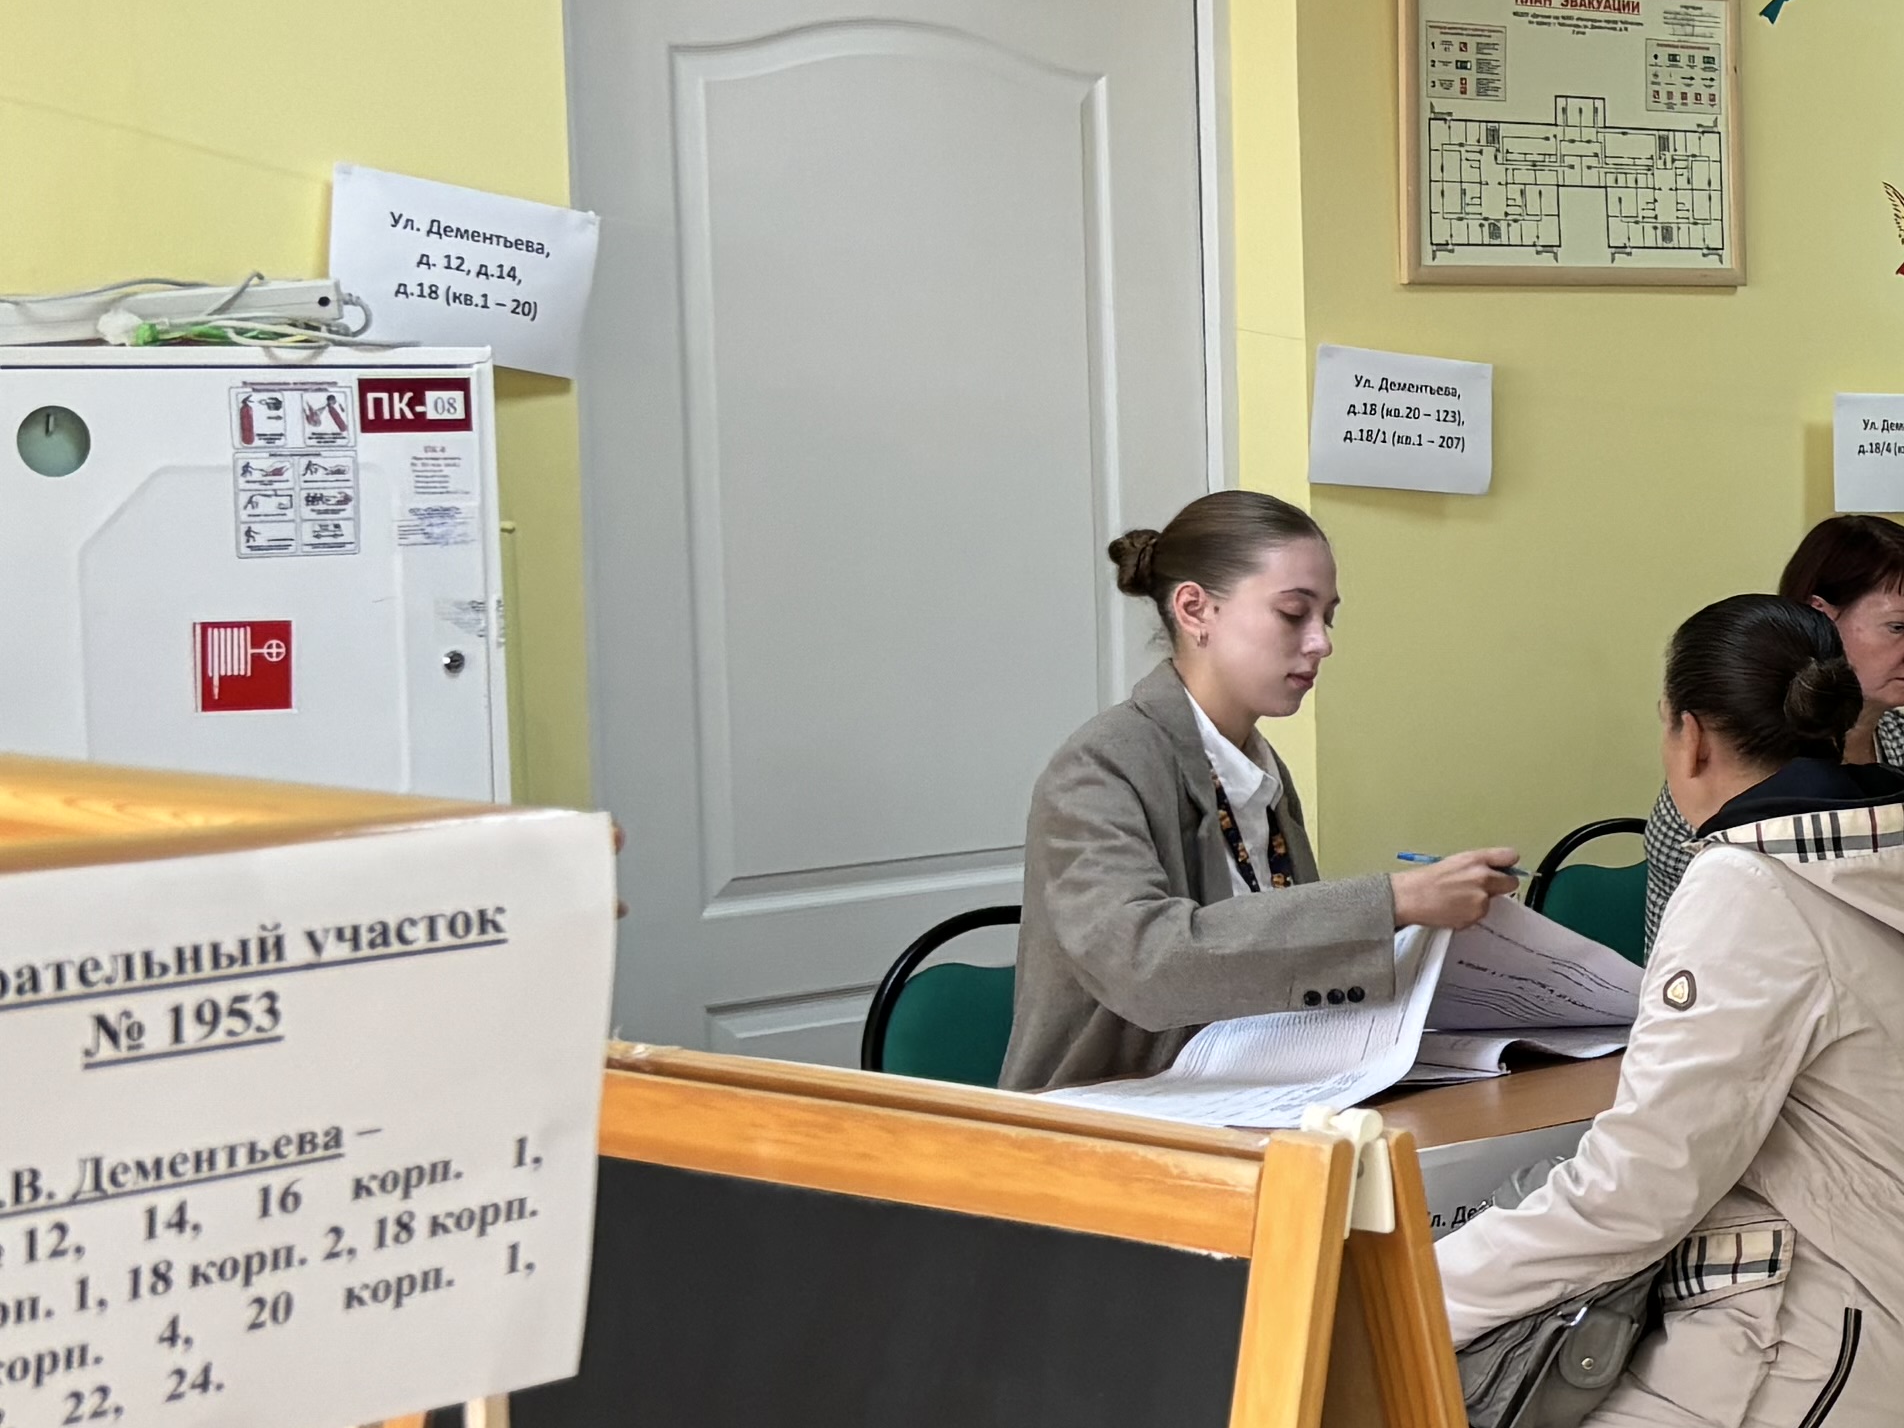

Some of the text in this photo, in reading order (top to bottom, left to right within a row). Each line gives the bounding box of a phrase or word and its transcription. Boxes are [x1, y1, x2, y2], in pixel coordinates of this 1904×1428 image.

[390, 212, 550, 258] Ул. Дементьева,
[416, 253, 522, 286] д. 12, д.14,
[394, 282, 439, 300] д.18
[446, 285, 490, 309] (кв.1
[511, 299, 537, 322] 20)
[1354, 374, 1461, 400] Ул. Дементьева,
[1343, 429, 1387, 444] д.18/1
[1438, 435, 1465, 453] 207)
[1347, 402, 1377, 416] д.18
[1435, 409, 1464, 427] 123),
[1863, 419, 1878, 430] Ул.
[303, 905, 508, 965] участок
[82, 990, 282, 1058] № 1953
[69, 1125, 344, 1202] Дементьева
[24, 1221, 86, 1265] 12,
[143, 1199, 202, 1241] 14,
[257, 1178, 302, 1219] 16
[351, 1159, 463, 1201] корп.
[512, 1135, 543, 1172] 1,
[75, 1275, 109, 1316] 1,
[127, 1259, 174, 1302] 18
[189, 1244, 308, 1288] корп.
[322, 1225, 358, 1263] 2,
[373, 1210, 416, 1251] 18
[427, 1196, 538, 1239] корп.
[157, 1313, 194, 1351] 4,
[246, 1290, 295, 1332] 20
[343, 1266, 455, 1311] корп.
[504, 1240, 536, 1280] 1,
[61, 1384, 124, 1427] 22,
[164, 1361, 225, 1404] 24.
